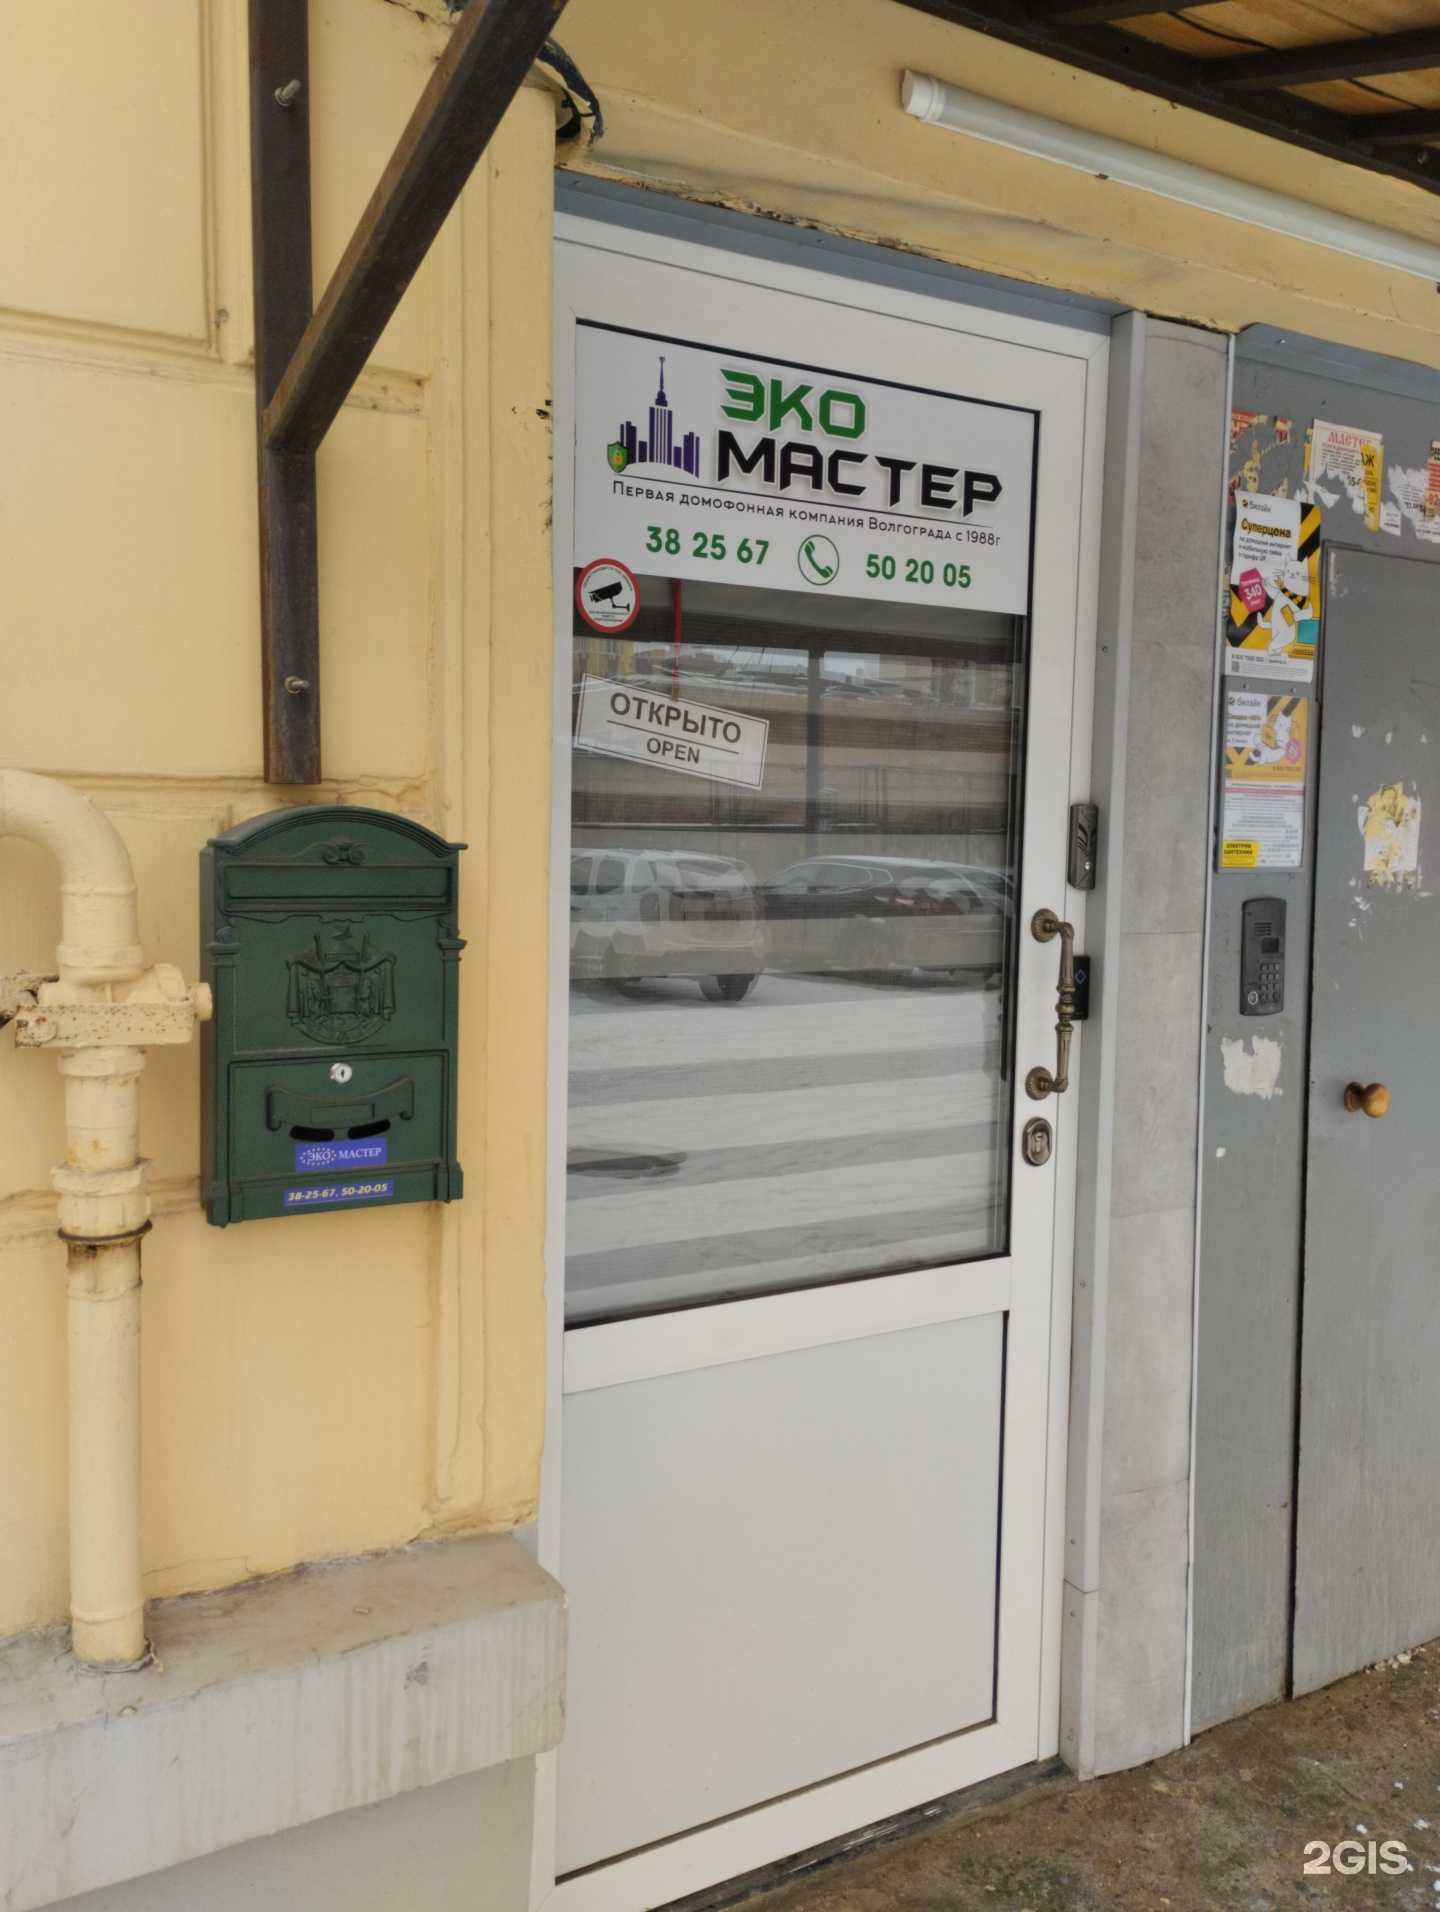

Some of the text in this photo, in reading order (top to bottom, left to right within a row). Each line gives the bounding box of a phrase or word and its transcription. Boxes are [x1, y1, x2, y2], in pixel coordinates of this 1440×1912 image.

[720, 368, 866, 440] ЭКО
[718, 430, 1003, 517] МАСТЕР
[1241, 518, 1292, 538] Суперцена
[646, 525, 769, 565] 38 25 67
[866, 553, 972, 588] 50 20 05
[610, 692, 742, 744] ОТКРЫТО
[646, 737, 700, 765] OPEN
[308, 1151, 331, 1162] ЭКО
[338, 1147, 382, 1160] МАСТЕР
[341, 1183, 388, 1197] 50-20-05
